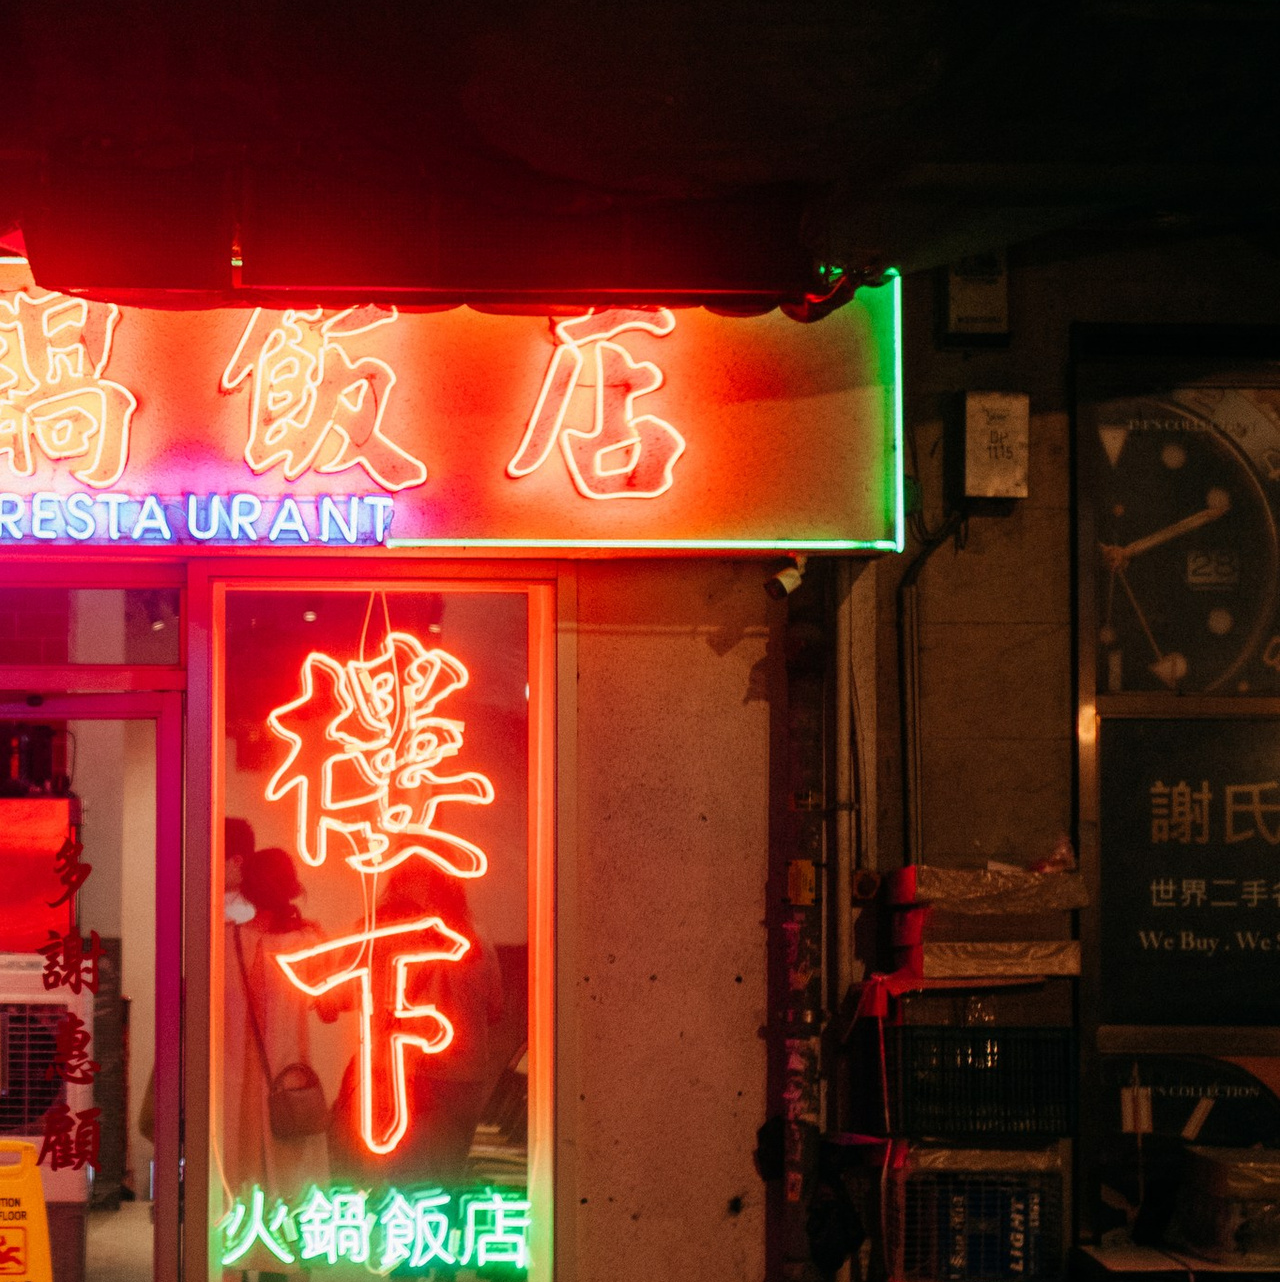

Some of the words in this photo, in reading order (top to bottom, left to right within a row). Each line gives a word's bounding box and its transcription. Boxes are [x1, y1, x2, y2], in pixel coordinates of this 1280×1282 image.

[1148, 779, 1280, 846] 謝氏
[265, 631, 496, 1155] 樓下
[1138, 930, 1174, 951] We
[1180, 930, 1220, 958] Buy
[1235, 930, 1271, 951] We
[36, 836, 107, 1174] 多謝惠顧
[222, 1186, 532, 1269] 火鍋飯店
[1009, 1196, 1026, 1273] LIGHT
